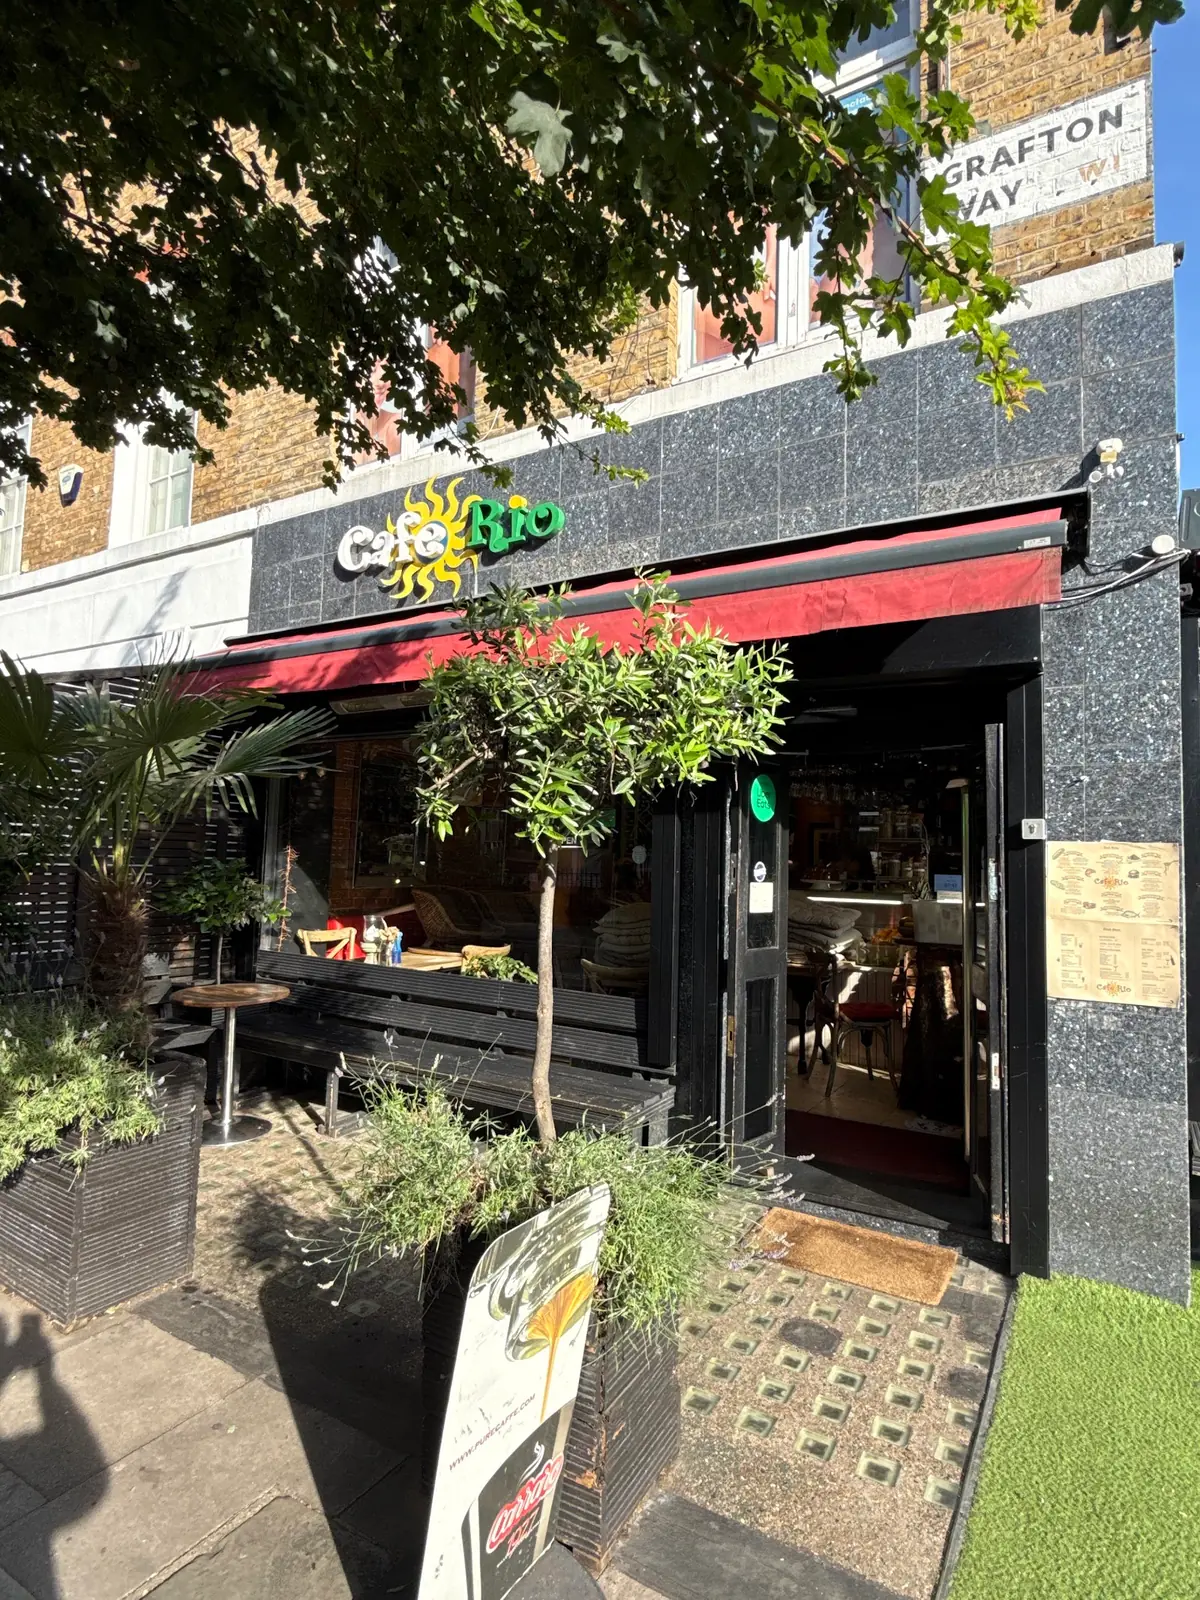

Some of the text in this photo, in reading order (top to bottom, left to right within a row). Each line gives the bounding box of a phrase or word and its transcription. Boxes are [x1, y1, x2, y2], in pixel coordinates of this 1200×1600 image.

[943, 103, 1123, 188] GRAFTON
[337, 494, 566, 573] Cafe Rio
[756, 798, 771, 809] Eats
[449, 1393, 536, 1471] WWW.PURECAFFE.COM
[487, 1455, 563, 1548] Carraro
[507, 1508, 540, 1558] 1927
